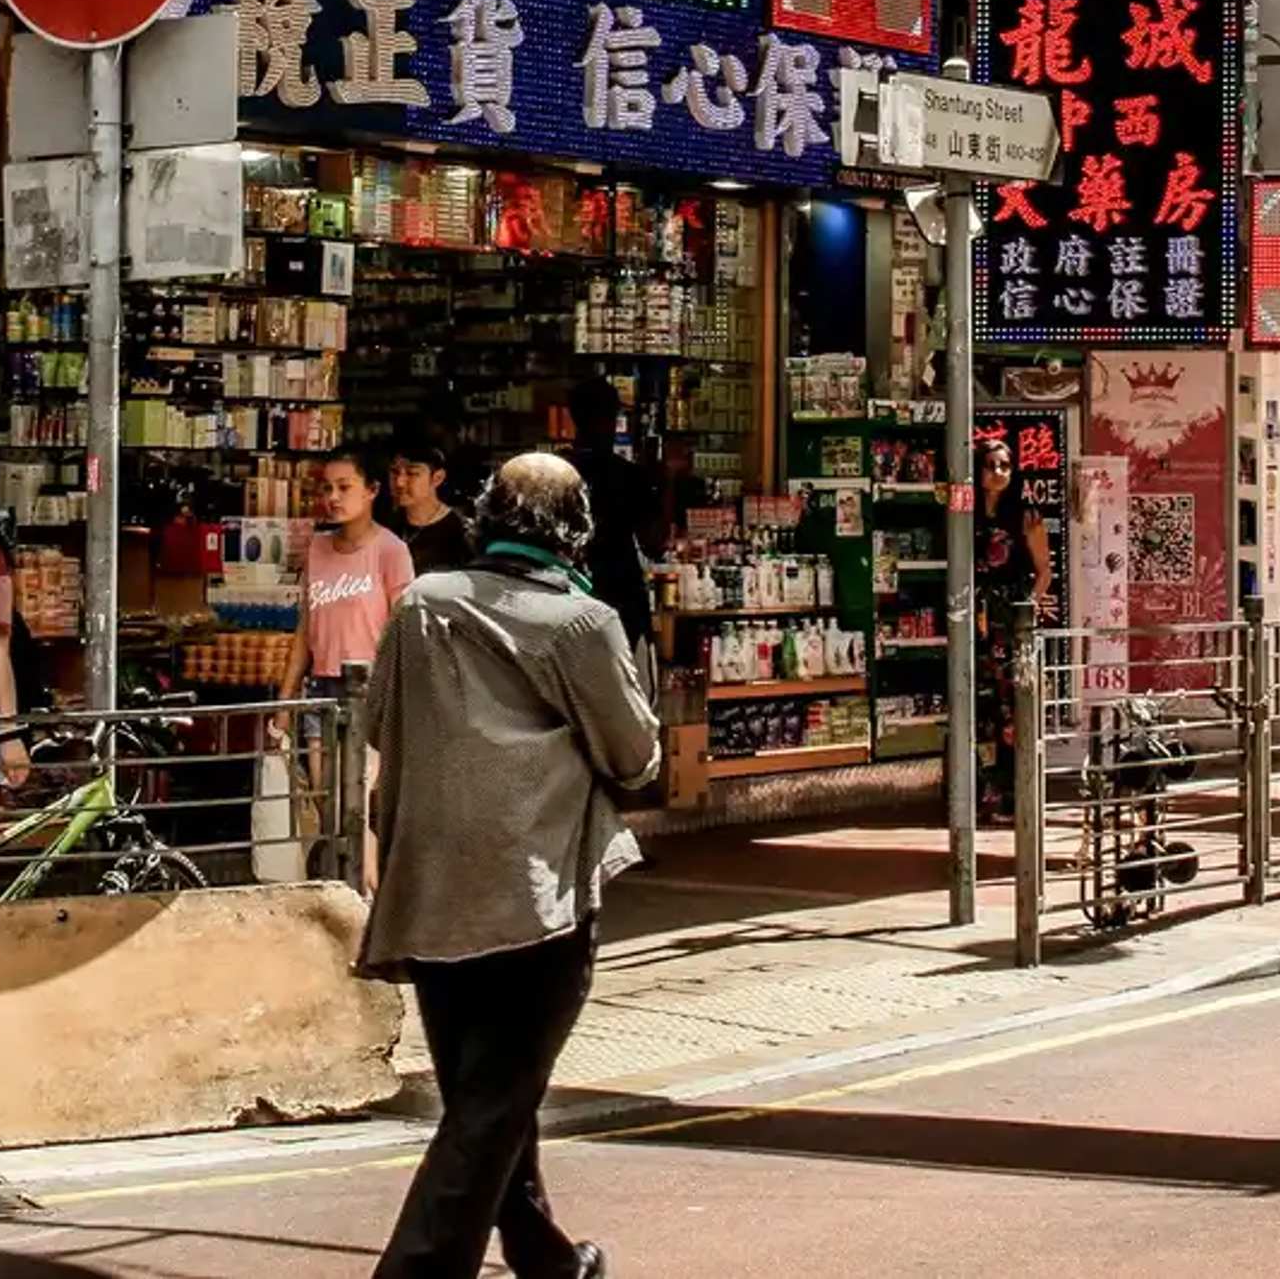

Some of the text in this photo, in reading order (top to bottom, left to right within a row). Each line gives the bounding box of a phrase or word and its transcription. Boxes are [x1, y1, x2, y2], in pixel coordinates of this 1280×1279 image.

[580, 0, 898, 159] 信心保
[924, 88, 1024, 124] Shantung Street
[948, 129, 1001, 157] 山東街
[1000, 234, 1207, 276] 政府註冊
[1000, 277, 1206, 321] 信心保證
[1021, 479, 1061, 505] ACE
